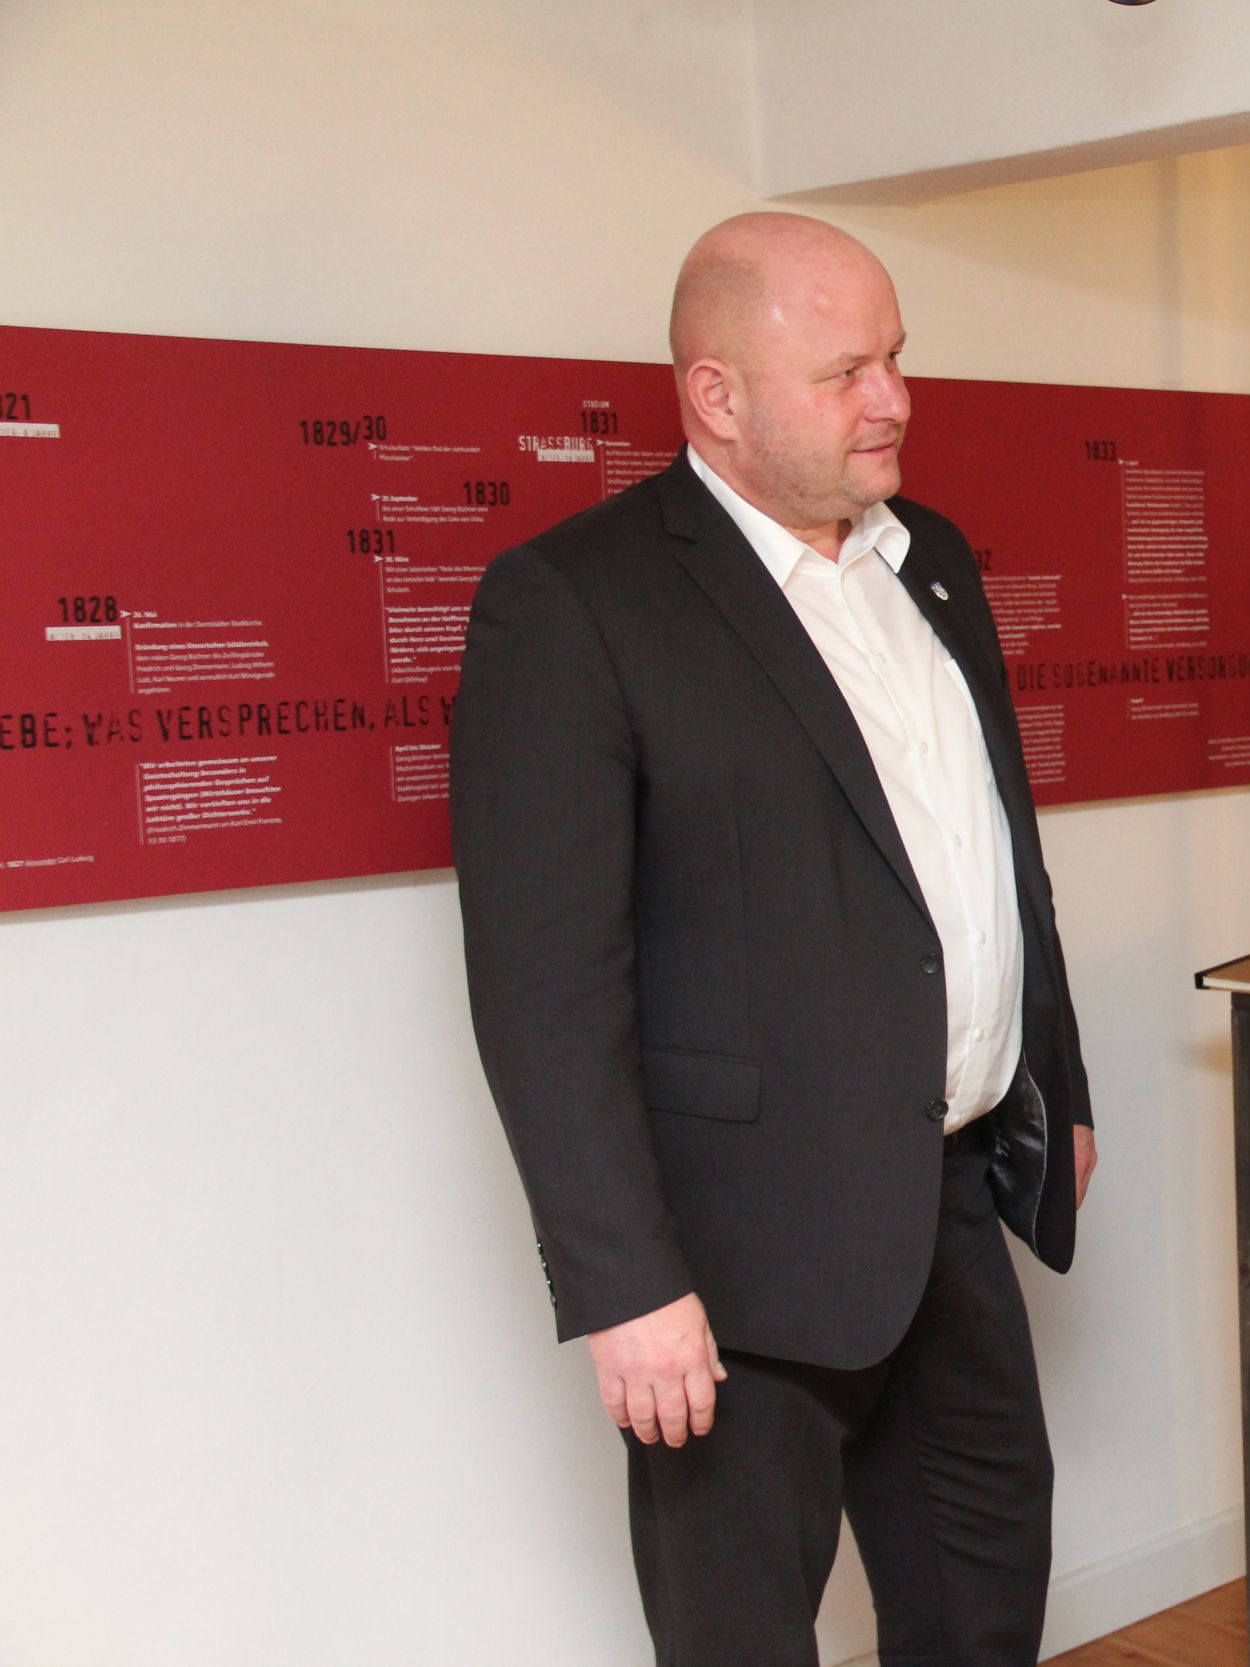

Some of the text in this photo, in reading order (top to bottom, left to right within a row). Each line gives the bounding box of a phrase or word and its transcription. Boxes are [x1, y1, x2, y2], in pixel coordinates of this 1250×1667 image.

[0, 393, 31, 420] 21
[300, 415, 387, 446] 1829/30
[579, 411, 618, 434] 1831
[1085, 440, 1117, 461] 1833
[463, 481, 510, 506] 1830
[347, 529, 396, 554] 1831
[58, 596, 117, 623] 1828
[156, 698, 376, 743] VERSPRECHEN,
[384, 695, 431, 729] ALS
